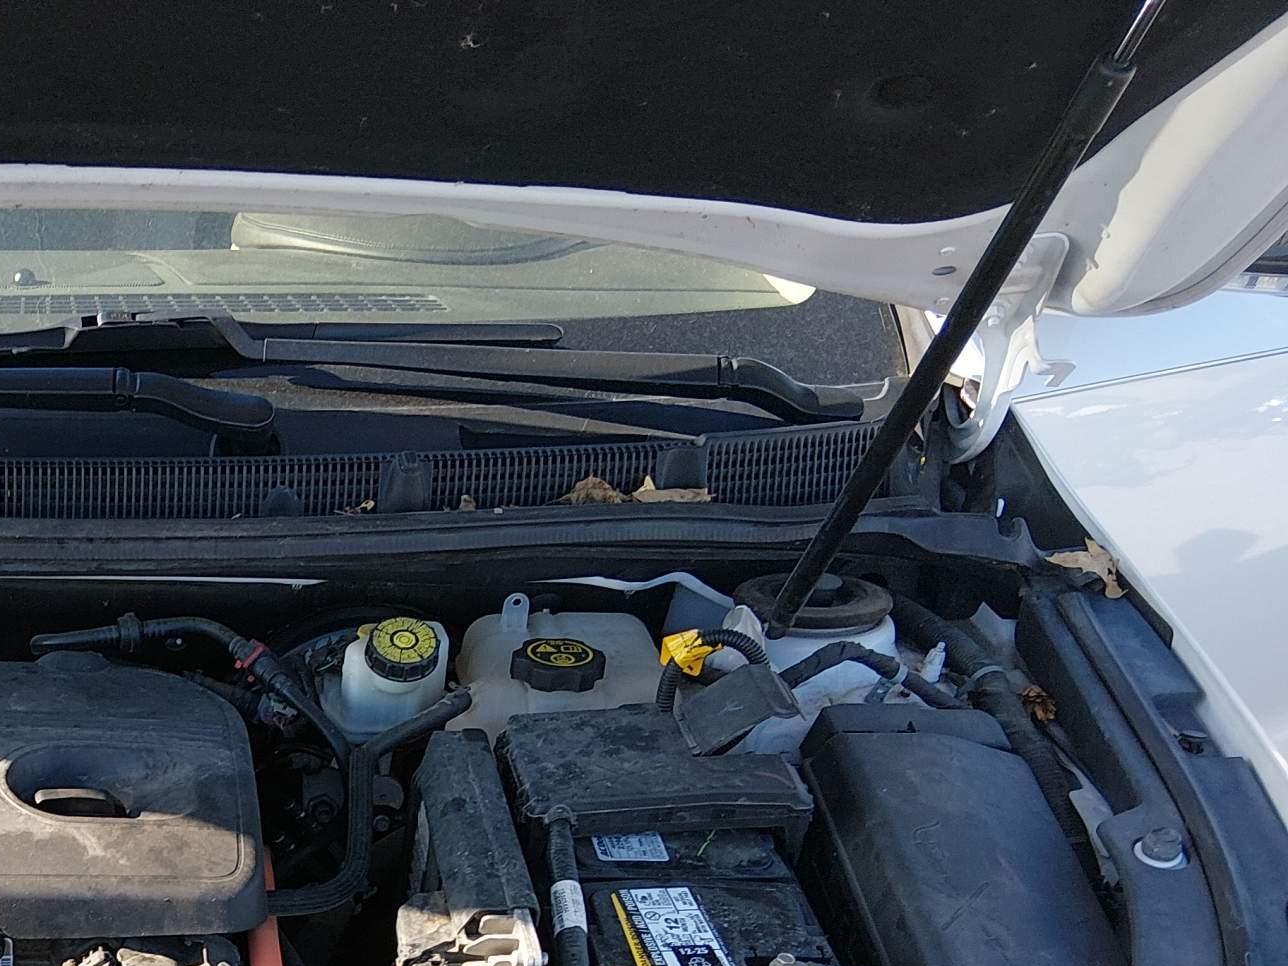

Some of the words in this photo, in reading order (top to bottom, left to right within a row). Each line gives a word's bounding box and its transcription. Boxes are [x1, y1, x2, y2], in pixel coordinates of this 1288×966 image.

[618, 889, 637, 910] POISON
[631, 915, 647, 928] ACID
[666, 917, 681, 930] 12
[640, 933, 665, 965] EXPLOSIVE
[678, 947, 709, 955] 12-25
